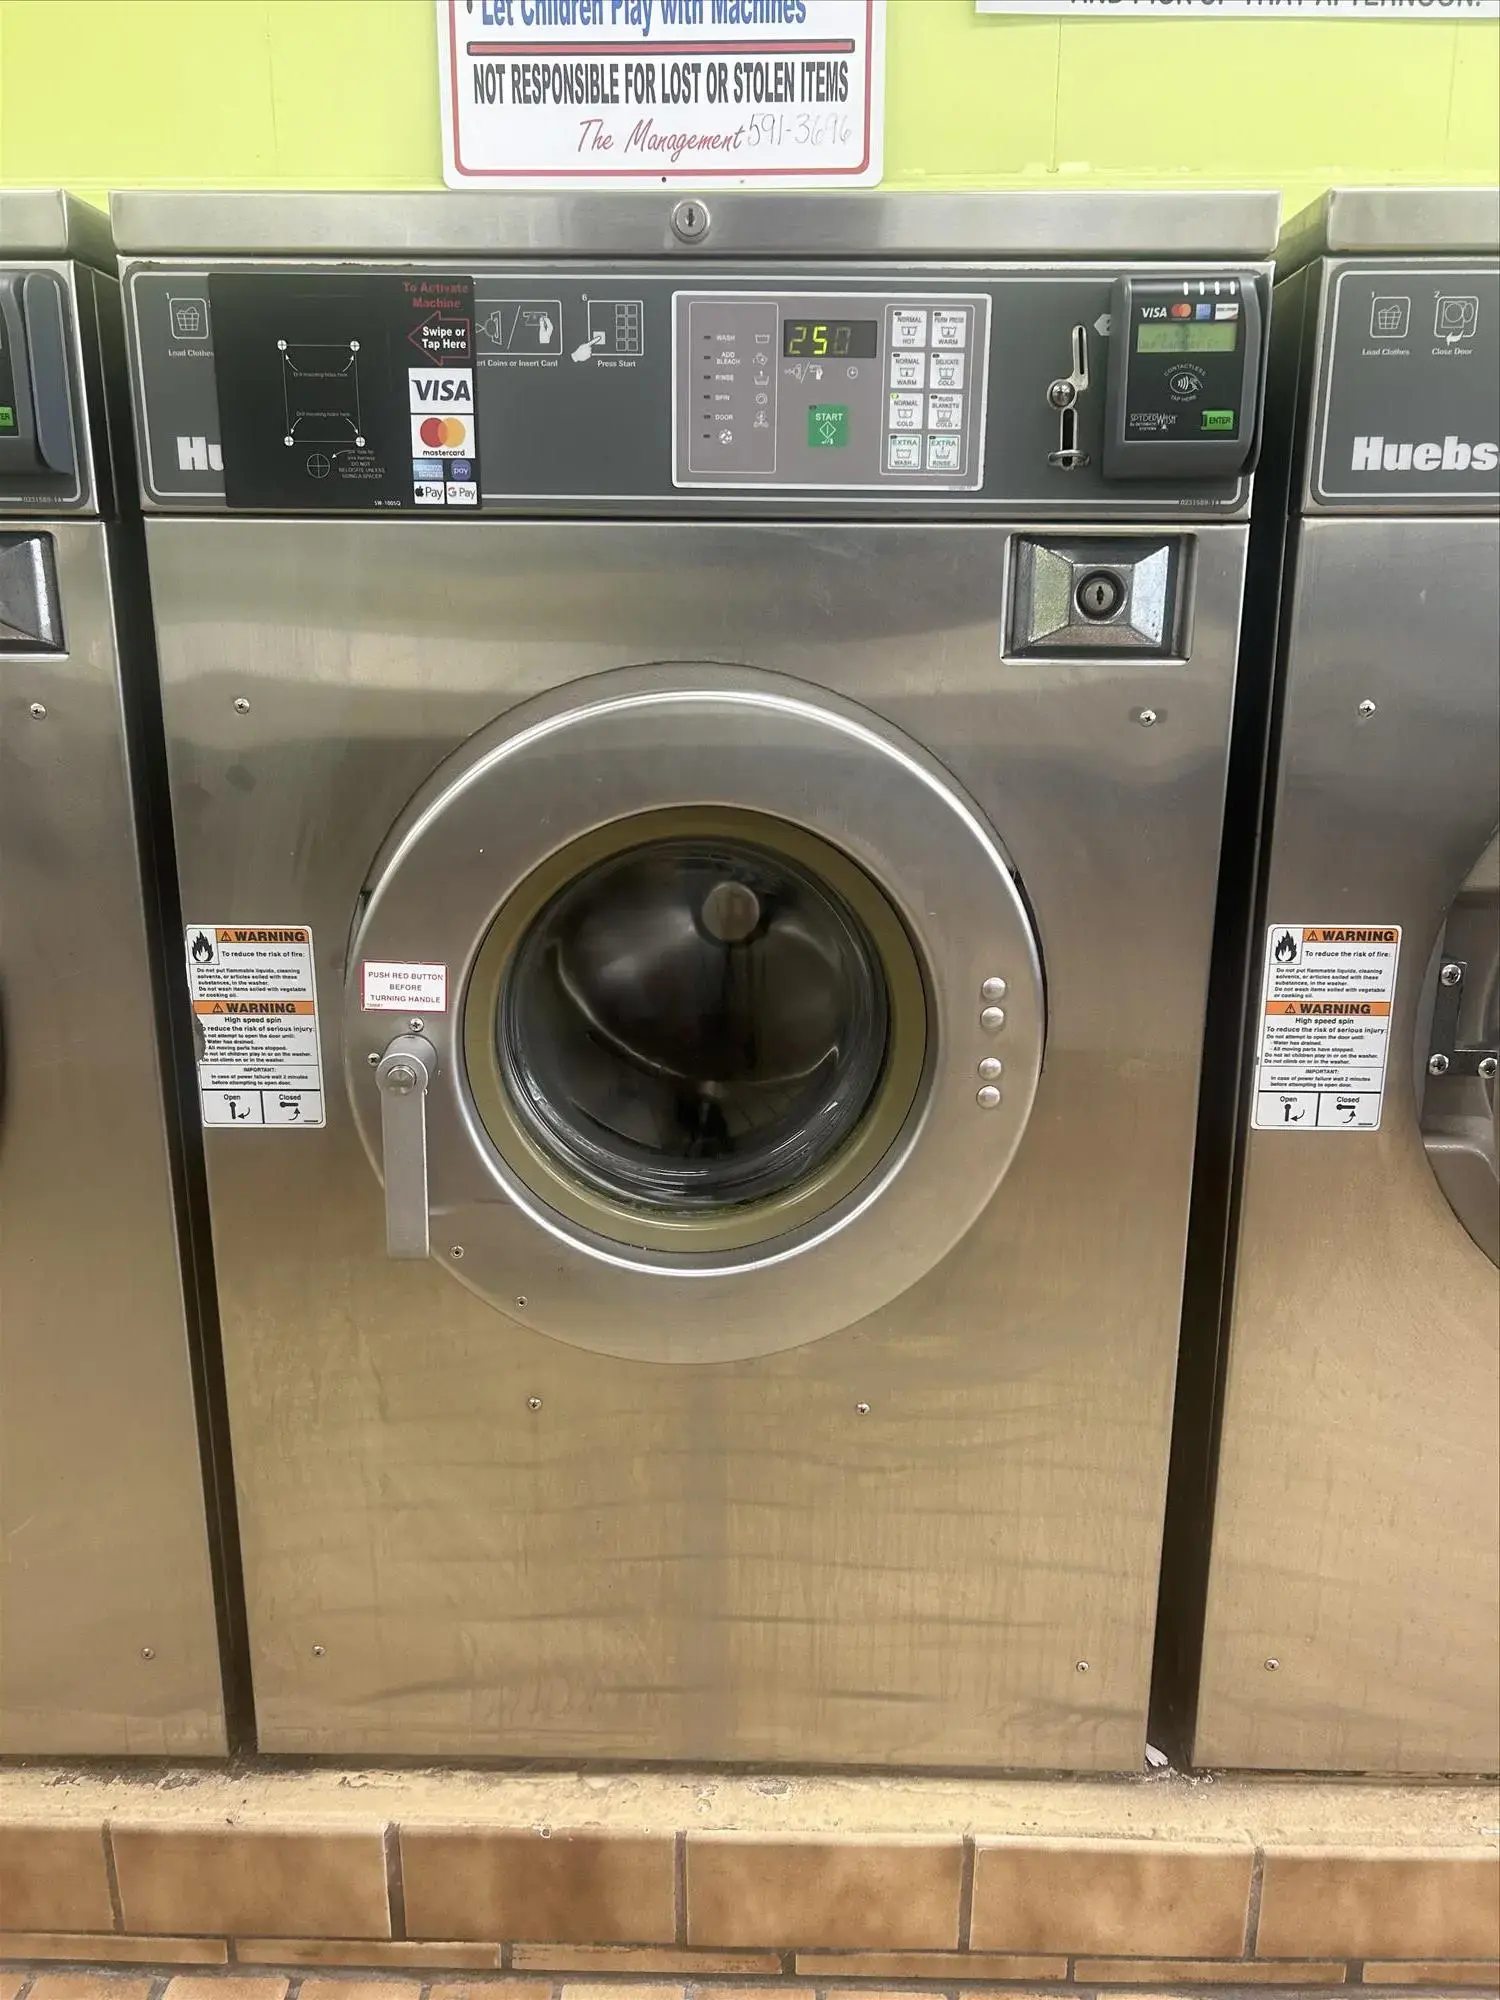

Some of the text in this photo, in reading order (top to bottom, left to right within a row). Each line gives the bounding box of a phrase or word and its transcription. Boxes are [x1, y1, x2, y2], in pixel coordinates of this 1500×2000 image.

[482, 0, 806, 36] Let Children Play with Machines
[474, 63, 848, 104] NOT RESPONSIBLE FOR LOST OR STOLEN ITEMS
[577, 118, 745, 162] The Management
[403, 282, 469, 293] To Activate
[1434, 290, 1441, 298] 2
[412, 297, 462, 308] Machine
[1141, 307, 1167, 318] VISA
[422, 326, 452, 339] Swipe
[422, 339, 467, 351] Tap Here
[1362, 348, 1410, 356] Load Clothes
[1432, 347, 1473, 356] Close Door
[1163, 362, 1206, 376] CONTACTLESS
[411, 380, 471, 401] VISA
[816, 413, 844, 421] START
[1208, 416, 1232, 424] ENTER
[422, 449, 466, 457] mastercard
[1351, 436, 1500, 471] Huebs
[454, 467, 468, 477] pay
[425, 487, 443, 500] Pay
[448, 488, 476, 500] G Pay
[234, 931, 305, 942] WARNING
[1322, 931, 1394, 941] WARNING
[226, 1003, 296, 1014] WARNING
[1300, 1004, 1371, 1014] WARNING
[1266, 1026, 1275, 1034] To
[1276, 1026, 1300, 1034] reduce
[1302, 1026, 1312, 1034] the
[1314, 1026, 1327, 1034] risk
[1328, 1026, 1336, 1034] of
[1338, 1026, 1362, 1034] serious
